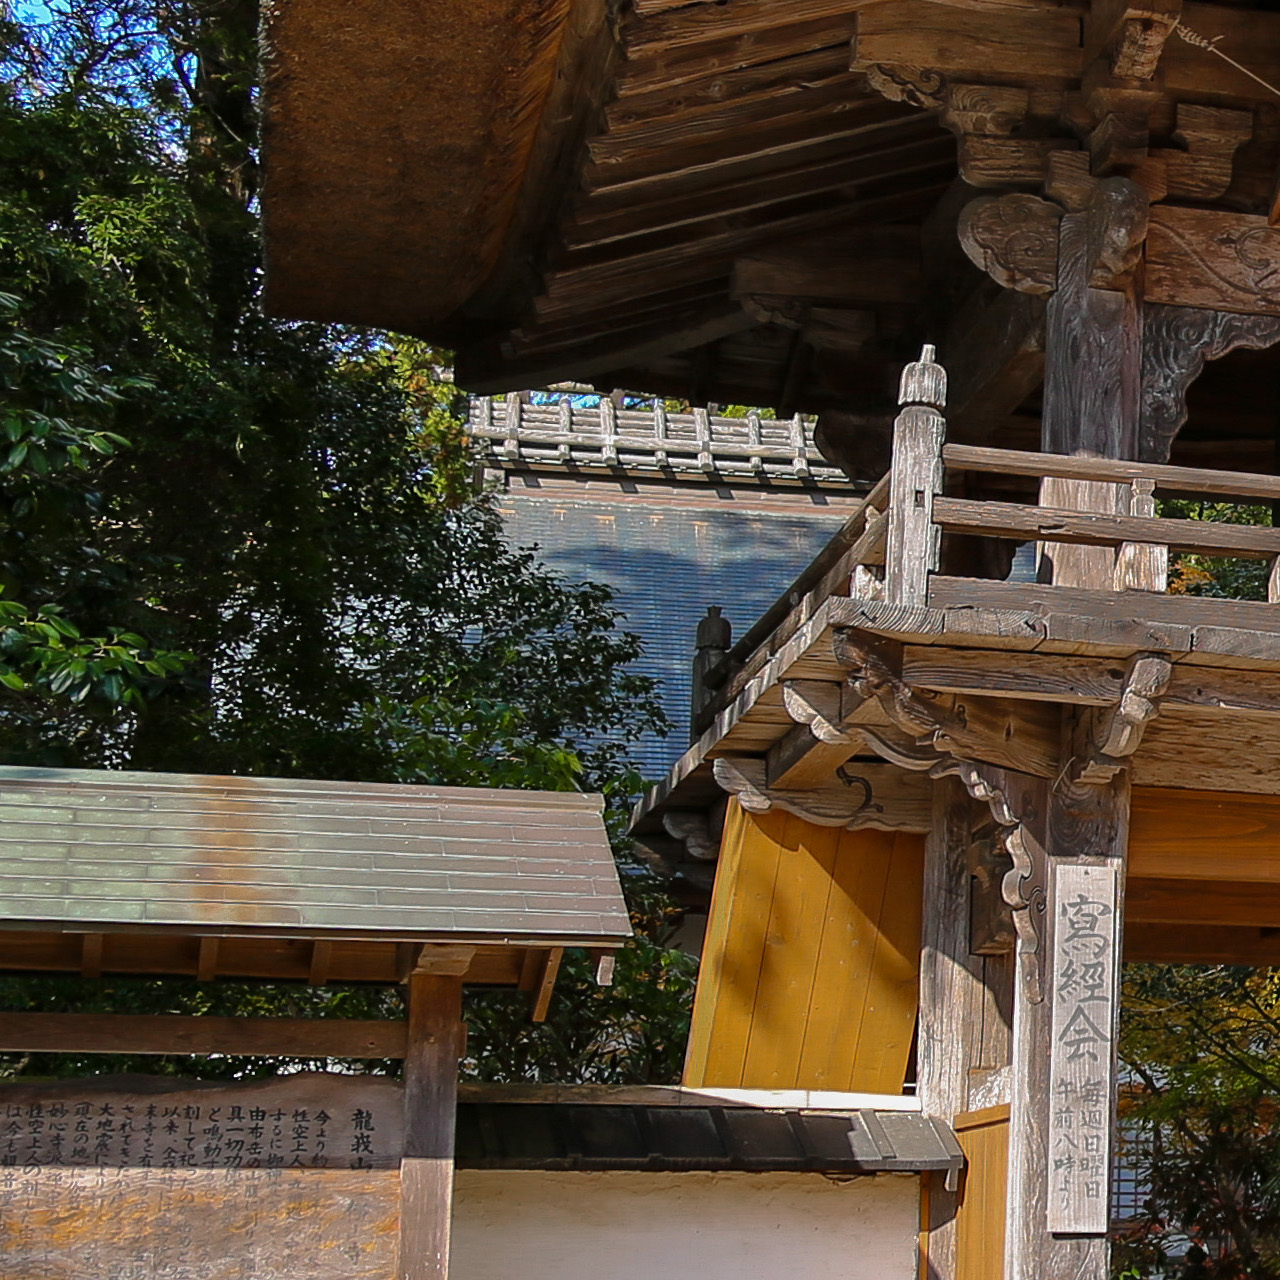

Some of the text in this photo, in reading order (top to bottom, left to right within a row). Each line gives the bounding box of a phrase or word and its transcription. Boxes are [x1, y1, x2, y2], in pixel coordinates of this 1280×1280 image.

[1053, 1077, 1079, 1211] 午前八時より
[1077, 1077, 1107, 1199] 毎週日曜日
